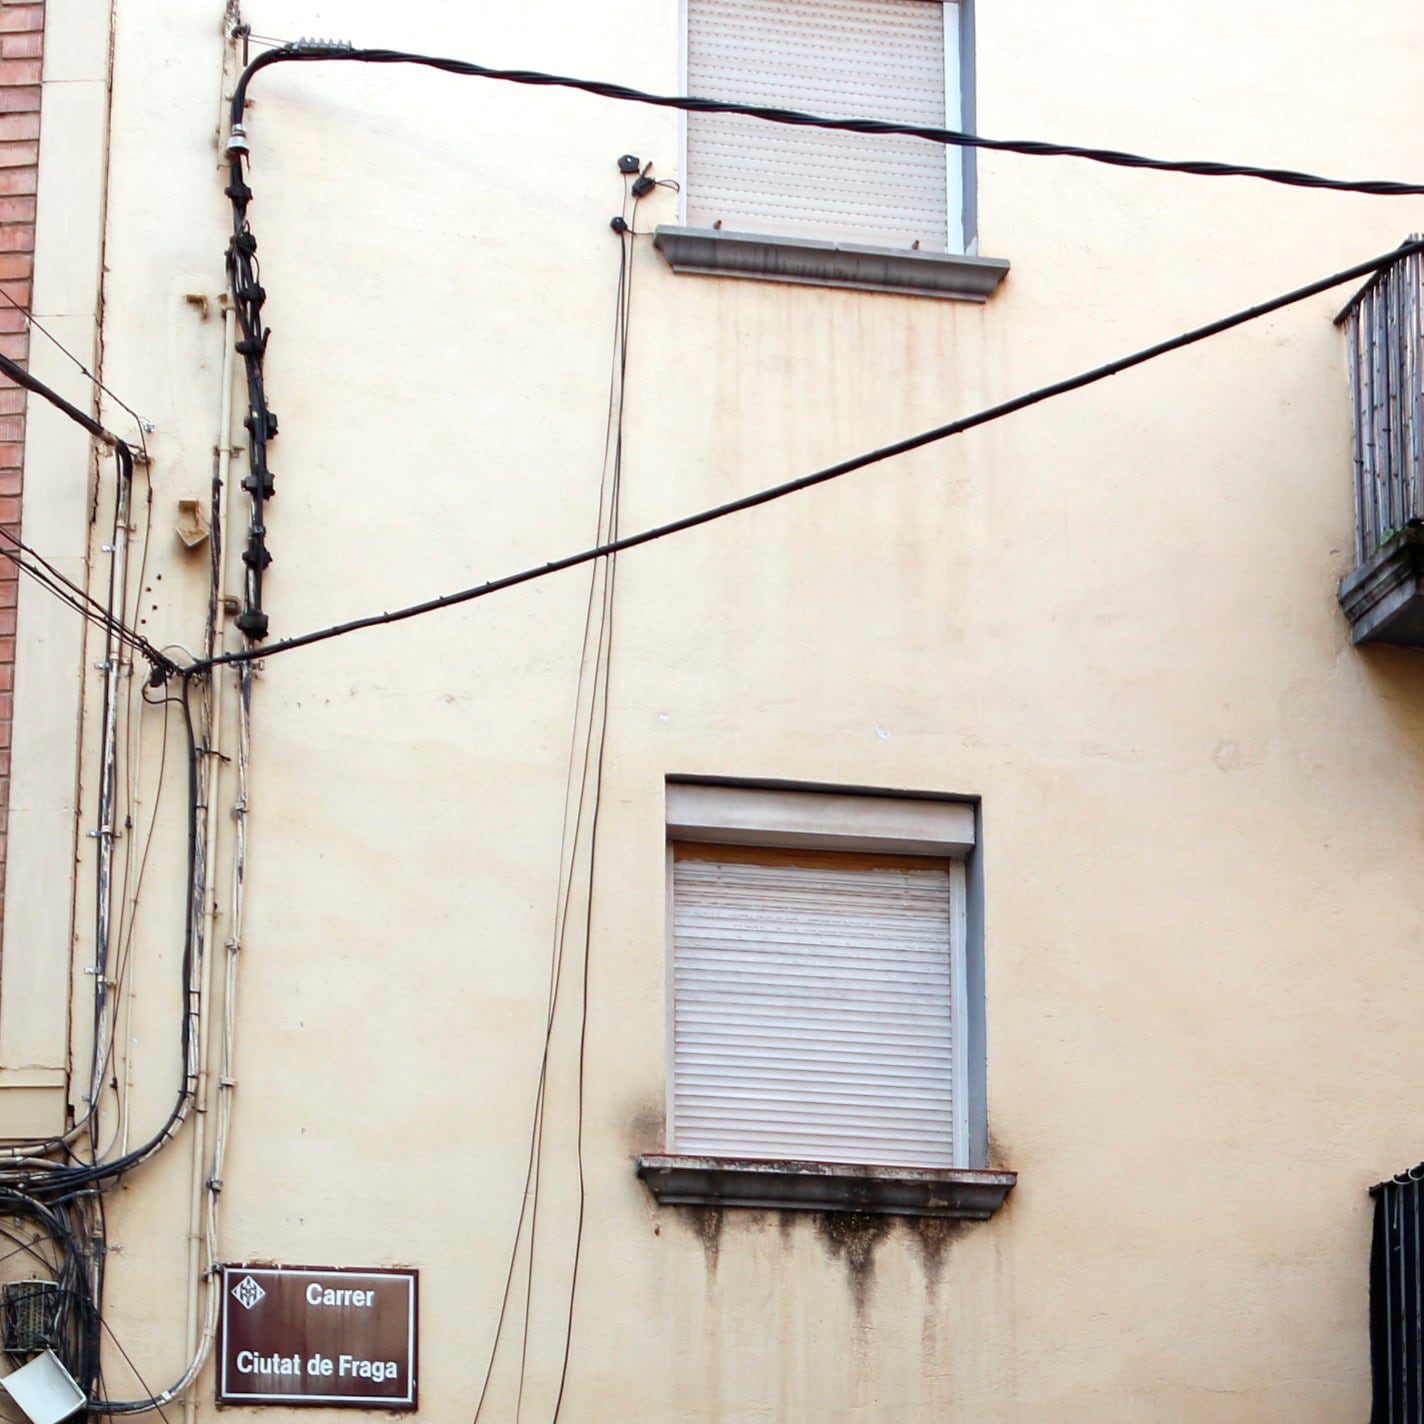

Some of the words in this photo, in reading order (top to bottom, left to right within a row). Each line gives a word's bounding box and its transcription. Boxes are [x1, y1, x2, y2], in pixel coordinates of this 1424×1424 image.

[305, 1283, 375, 1307] Carrer
[236, 1351, 301, 1375] Ciutat
[307, 1354, 333, 1377] de
[339, 1355, 398, 1382] Fraga
